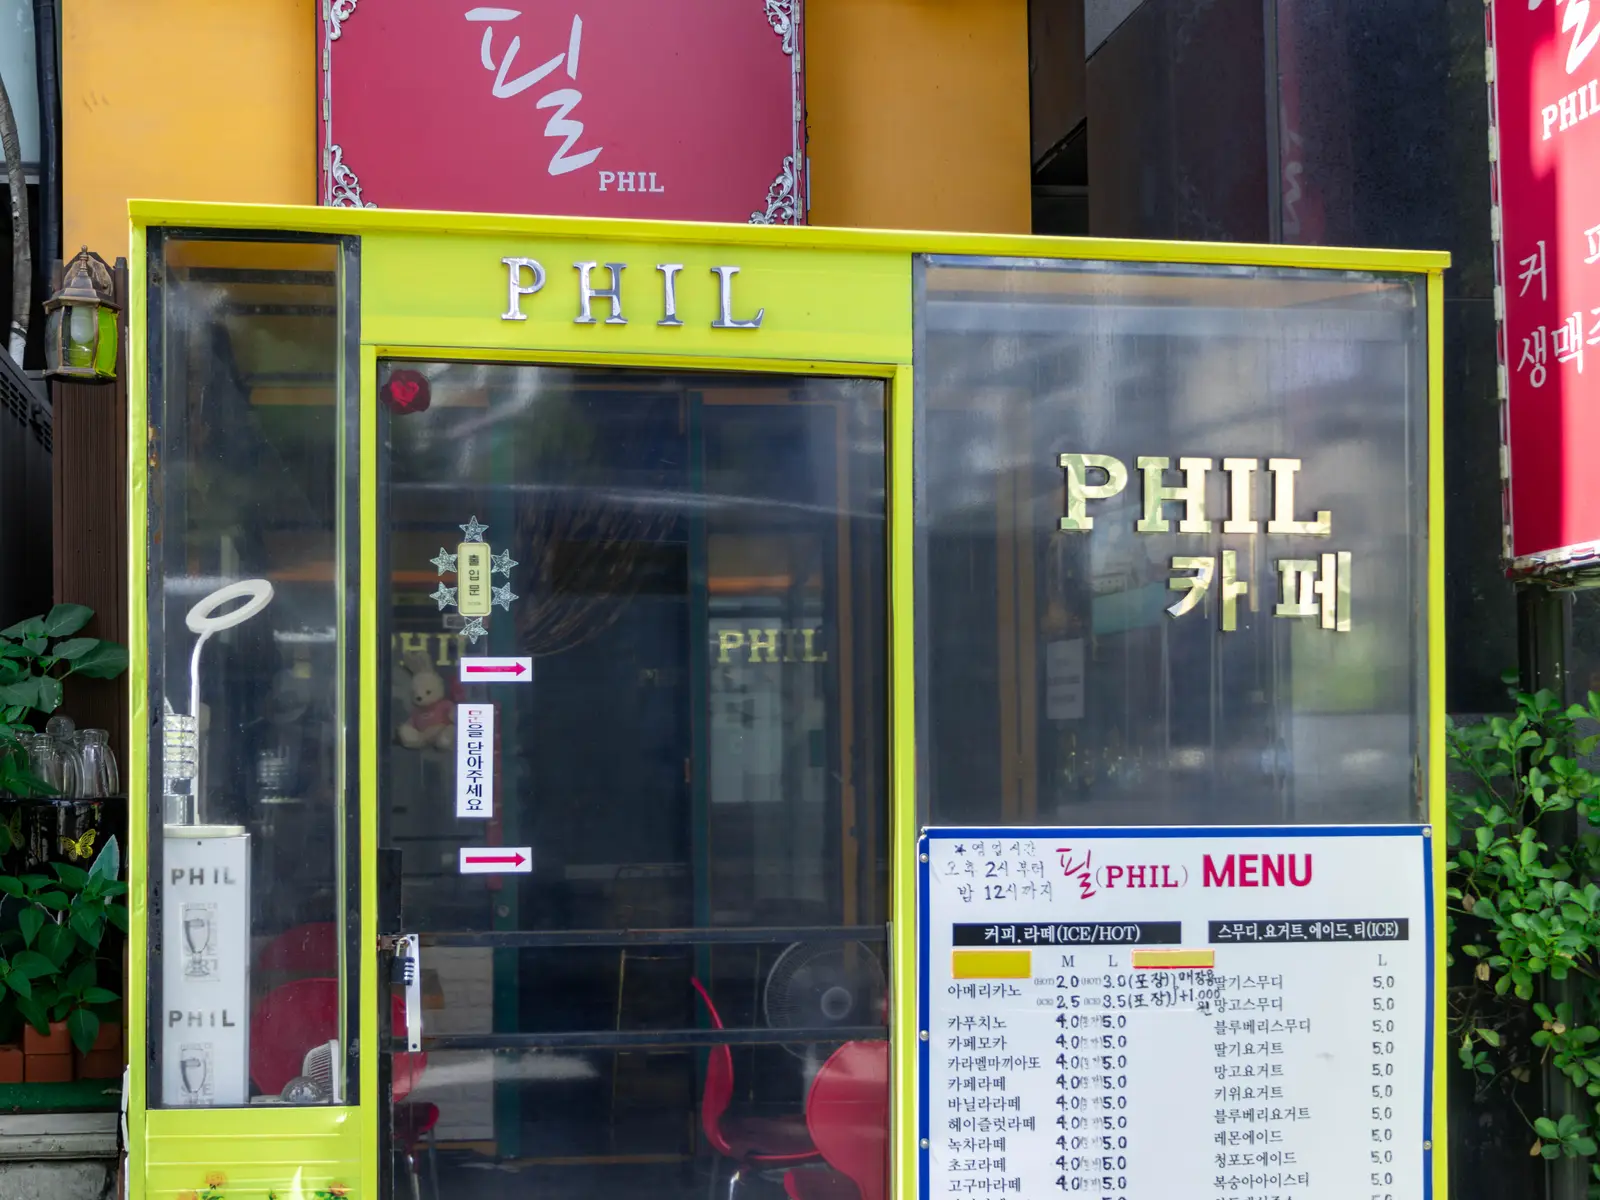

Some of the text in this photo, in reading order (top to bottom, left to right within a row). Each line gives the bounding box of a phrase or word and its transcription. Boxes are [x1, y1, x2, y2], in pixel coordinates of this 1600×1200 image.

[464, 7, 603, 176] 필
[1541, 79, 1600, 141] PHIL
[599, 171, 665, 192] PHIL
[501, 256, 764, 329] PHIL
[1058, 453, 1332, 535] PHIL
[468, 554, 480, 596] 출입문
[1165, 550, 1352, 632] 카페
[717, 628, 828, 663] PHIL
[465, 709, 484, 811] 문을 닫아주세요
[170, 867, 237, 886] PHIL
[1095, 865, 1189, 889] (PHIL)
[1202, 853, 1313, 888] MENU
[1062, 955, 1119, 968] M L
[1377, 953, 1388, 967] L
[948, 983, 1022, 999] 아메리카노
[1056, 975, 1080, 989] 2.0
[1103, 975, 1126, 989] 3.0
[1214, 975, 1394, 991] 딸기스무디 5.0
[1056, 995, 1080, 1009] 2.5
[1102, 994, 1126, 1009] 3.5
[1214, 997, 1394, 1014] 망고스무디 5.0
[168, 1009, 236, 1028] PHIL
[948, 1015, 1007, 1031] 카푸치노
[1055, 1013, 1079, 1029] 4.0
[1102, 1015, 1126, 1028] 5.0
[1214, 1018, 1394, 1035] 블루베리스무디 5.0
[948, 1035, 1007, 1051] 카페모카
[1055, 1033, 1080, 1050] 4.0
[1103, 1035, 1127, 1049] 5.0
[1214, 1041, 1394, 1057] 딸기요거트 5.0
[948, 1055, 1041, 1072] 카라멜마끼아또
[1056, 1053, 1080, 1070] 4.0
[1102, 1055, 1127, 1070] 5.0
[1214, 1063, 1393, 1080] 망고요거트 5.0
[948, 1076, 1005, 1092] 카페라떼
[1056, 1073, 1080, 1090] 4.0
[1103, 1075, 1127, 1089] 5.0
[1214, 1085, 1393, 1101] 키위요거트 5.0
[948, 1096, 1020, 1112] 바닐라라떼
[1056, 1094, 1080, 1111] 4.0
[1102, 1096, 1127, 1109] 5.0
[948, 1116, 1035, 1132] 헤이즐럿라떼
[1056, 1114, 1080, 1130] 4.0
[1103, 1116, 1127, 1130] 5.0
[1214, 1106, 1392, 1124] 블루베리요거트 5.0
[948, 1137, 1005, 1152] 녹차라떼
[1056, 1135, 1080, 1151] 4.0
[1102, 1136, 1127, 1150] 5.0
[1214, 1128, 1392, 1146] 레몬에이드 5.0
[948, 1157, 1005, 1172] 초코라떼
[1055, 1155, 1080, 1171] 4.0
[1102, 1156, 1126, 1170] 5.0
[1214, 1150, 1392, 1168] 청포도에이드 5.0
[949, 1177, 1020, 1193] 고구마라떼
[1055, 1174, 1080, 1191] 4.0
[1102, 1176, 1127, 1190] 5.0
[1213, 1171, 1393, 1190] 복숭아아이스티 5.0
